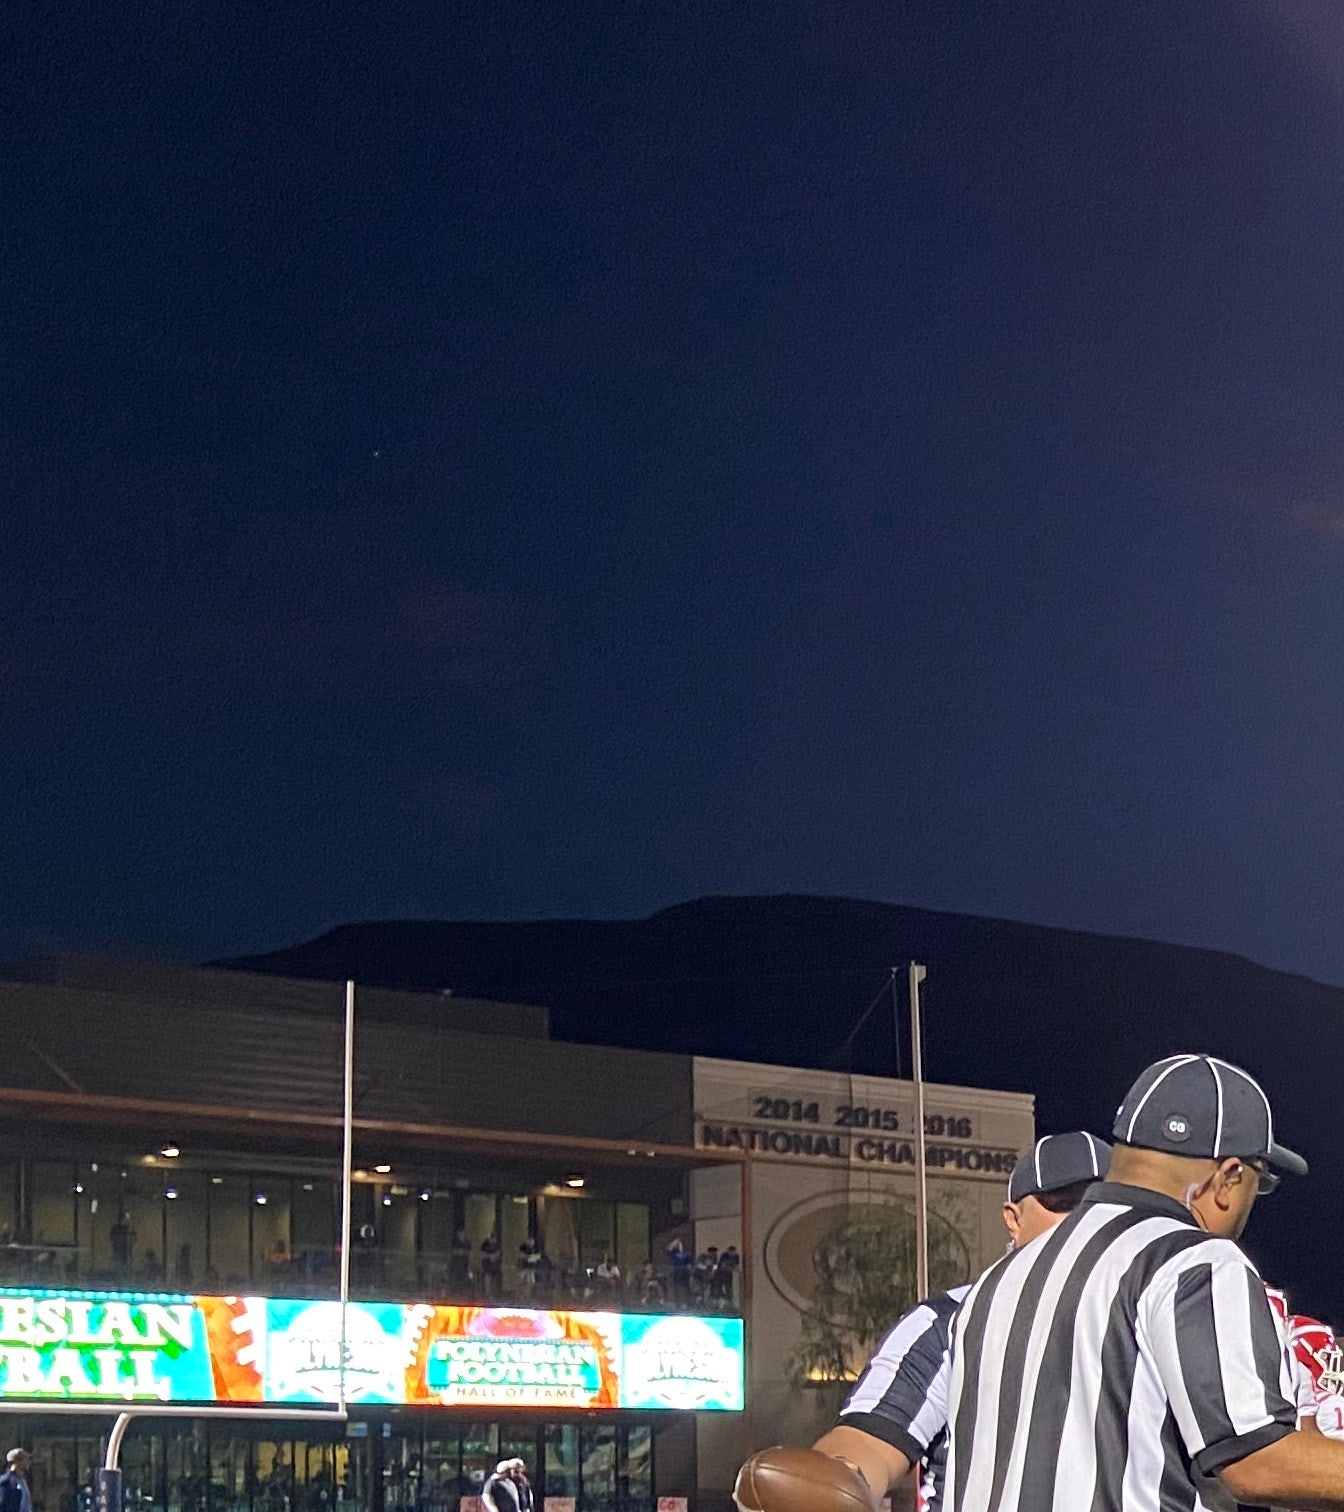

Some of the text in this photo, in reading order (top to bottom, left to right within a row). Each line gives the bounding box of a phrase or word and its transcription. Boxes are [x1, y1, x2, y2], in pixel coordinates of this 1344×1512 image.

[752, 1096, 820, 1123] 2014
[834, 1105, 899, 1132] 2015
[703, 1125, 849, 1158] NATIONAL
[0, 1297, 196, 1354] ESIAN
[456, 1386, 577, 1399] HALL OF FAME
